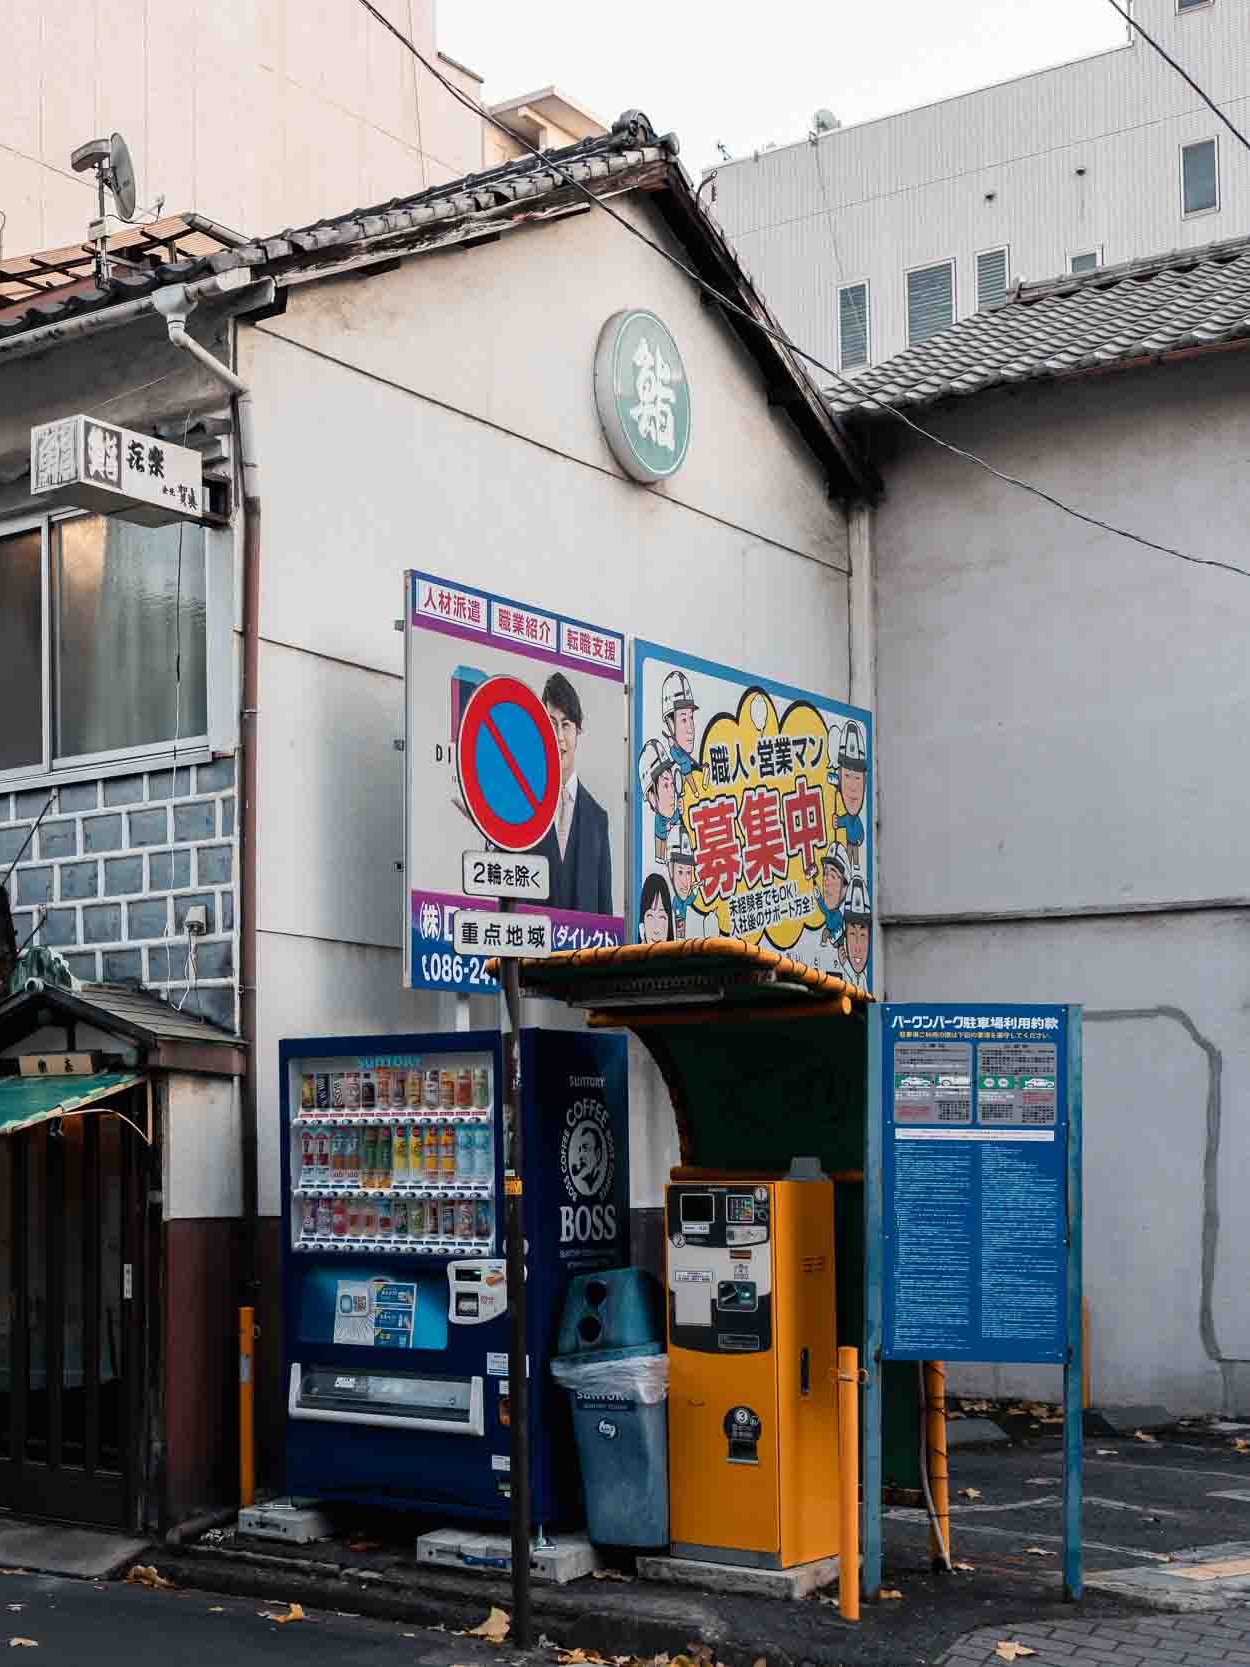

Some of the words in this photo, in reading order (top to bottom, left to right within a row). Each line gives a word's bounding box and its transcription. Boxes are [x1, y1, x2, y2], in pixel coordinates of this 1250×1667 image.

[424, 585, 482, 625] 人材派遣
[498, 607, 552, 645] 職業紹介
[567, 627, 617, 663] 転職支援
[709, 735, 824, 786] 職人・営業マン
[689, 775, 826, 903] 募集中
[472, 861, 542, 889] 2輪を除く
[460, 921, 547, 950] 重点地域
[559, 1204, 617, 1243] BOSS
